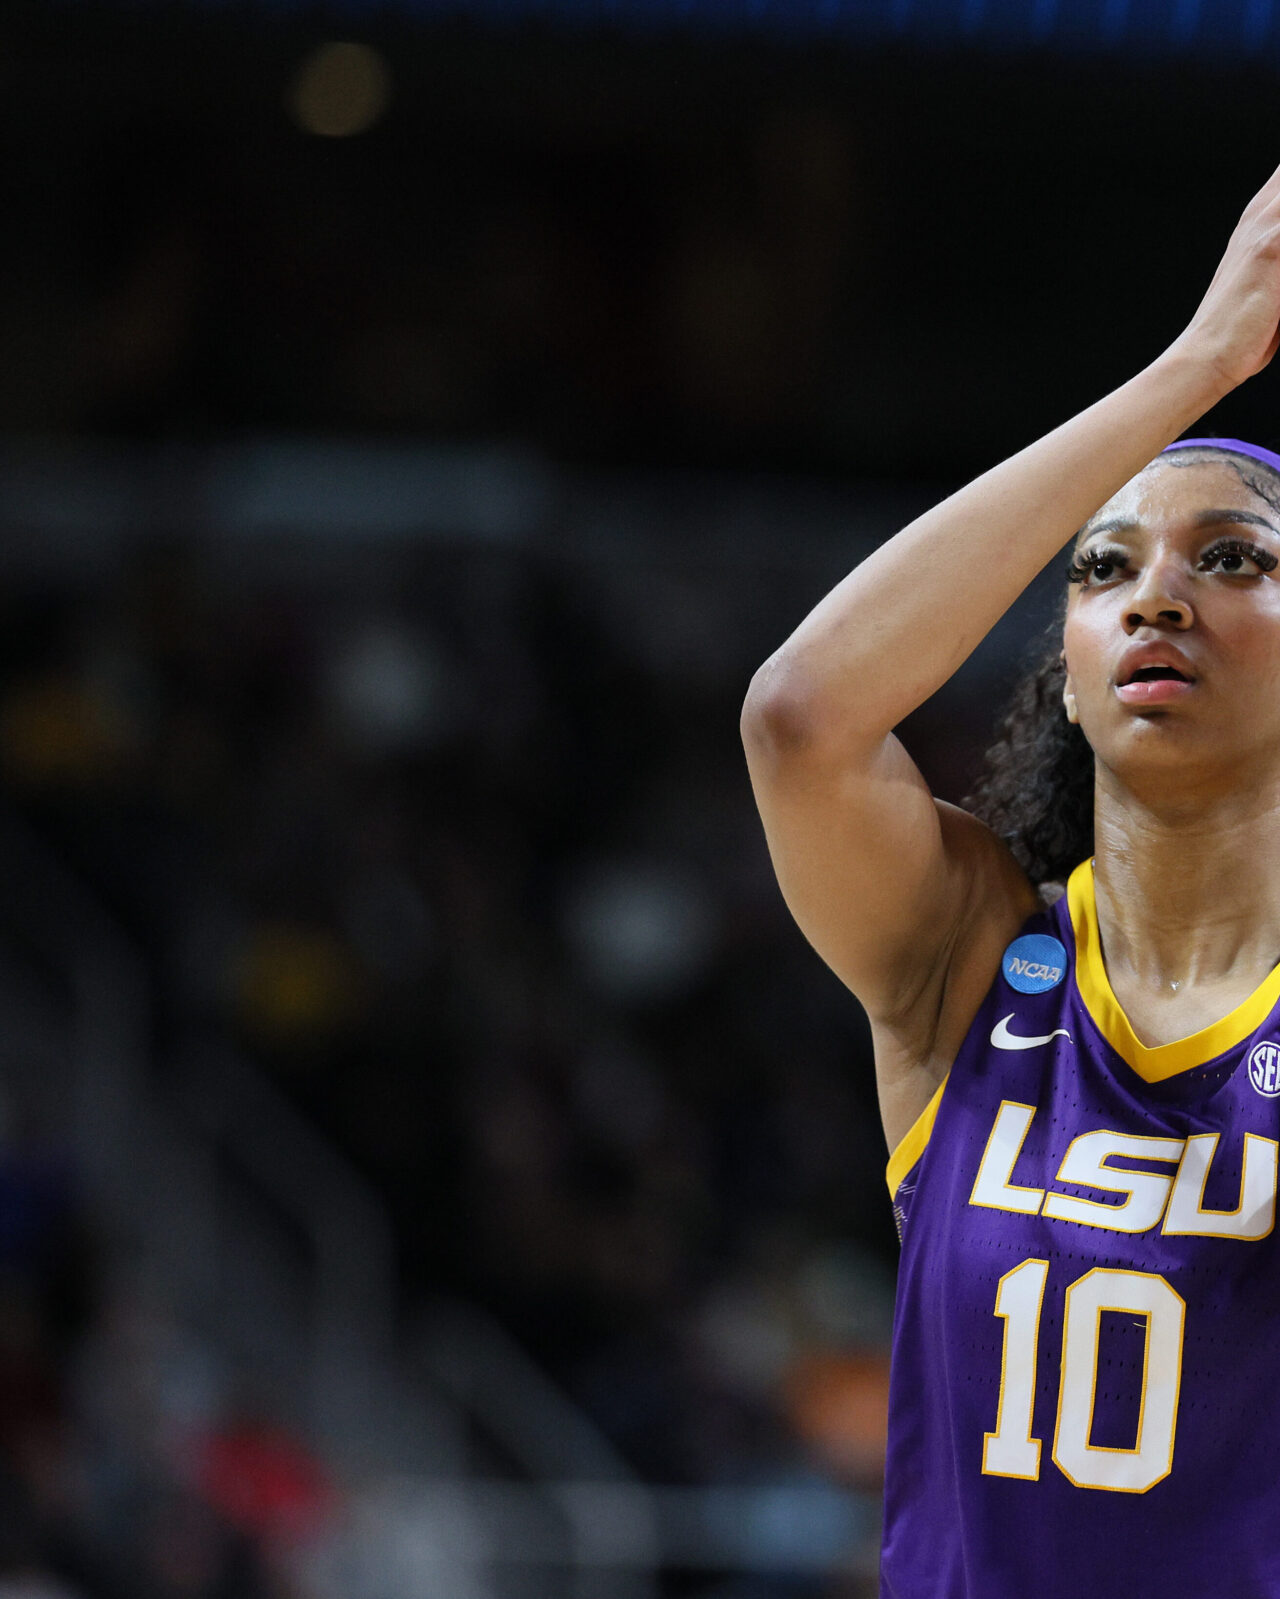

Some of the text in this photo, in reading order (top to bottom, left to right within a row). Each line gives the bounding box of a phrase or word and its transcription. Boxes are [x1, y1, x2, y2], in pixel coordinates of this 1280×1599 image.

[1008, 957, 1062, 982] NCAA
[969, 1100, 1279, 1241] LSU
[981, 1258, 1187, 1494] 10
